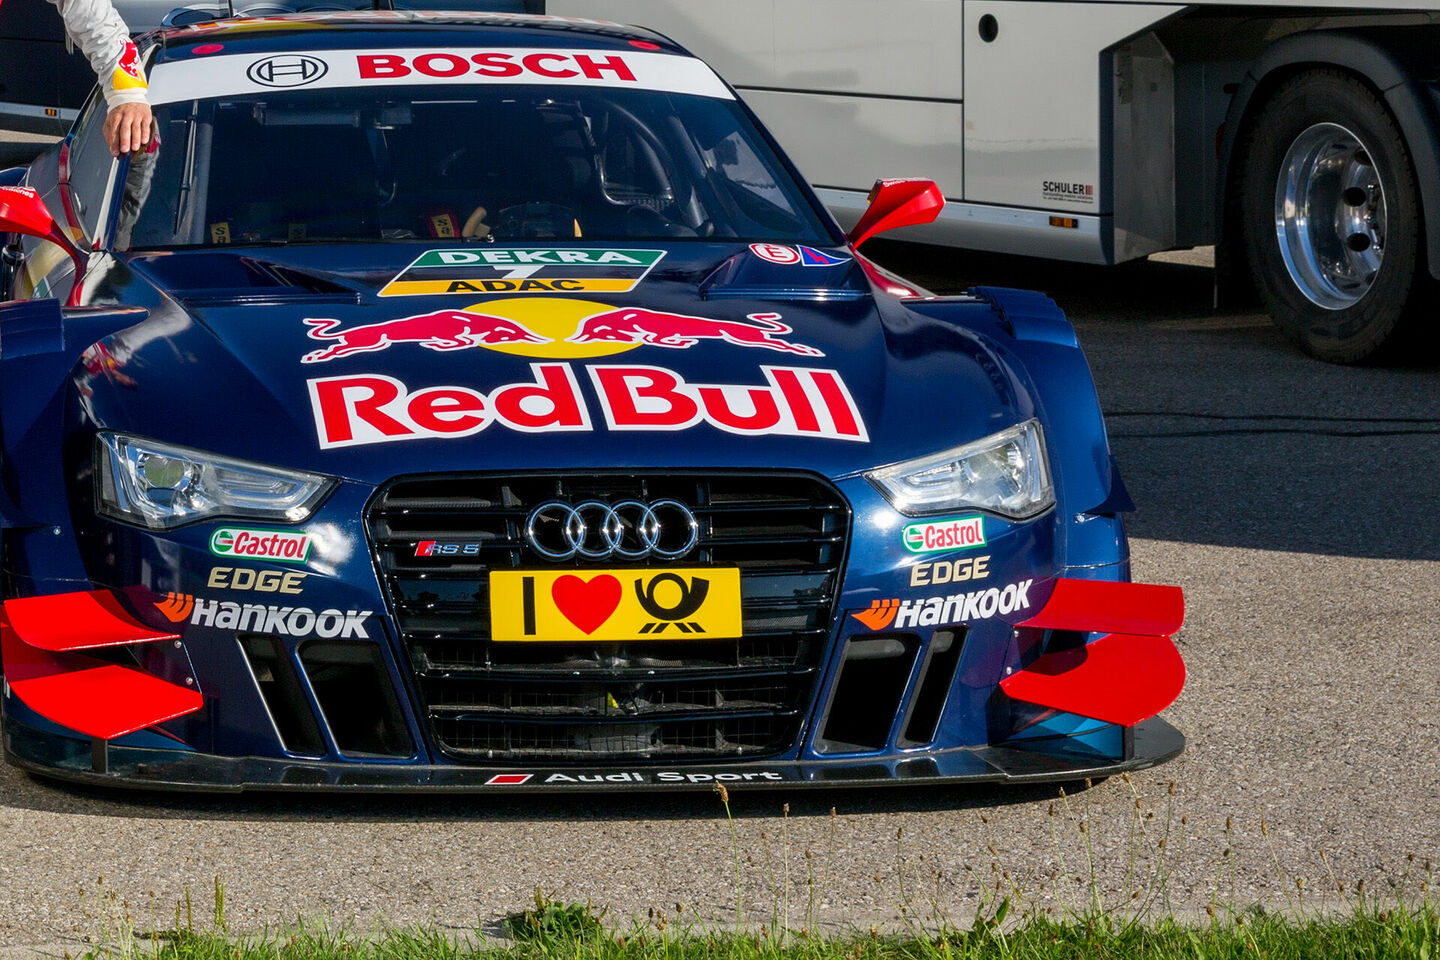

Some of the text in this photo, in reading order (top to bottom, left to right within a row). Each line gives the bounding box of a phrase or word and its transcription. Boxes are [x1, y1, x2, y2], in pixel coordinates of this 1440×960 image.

[356, 53, 637, 82] BOSCH
[1043, 181, 1085, 195] SCHULER
[438, 249, 643, 265] DEKRA
[446, 279, 585, 293] ADAC
[307, 362, 870, 450] Red Bull
[232, 530, 308, 559] Castrol
[924, 517, 983, 548] Castrol
[207, 567, 308, 595] EDGE
[910, 554, 991, 587] EDGE
[522, 576, 536, 636] I
[544, 771, 783, 784] Audi Sport
